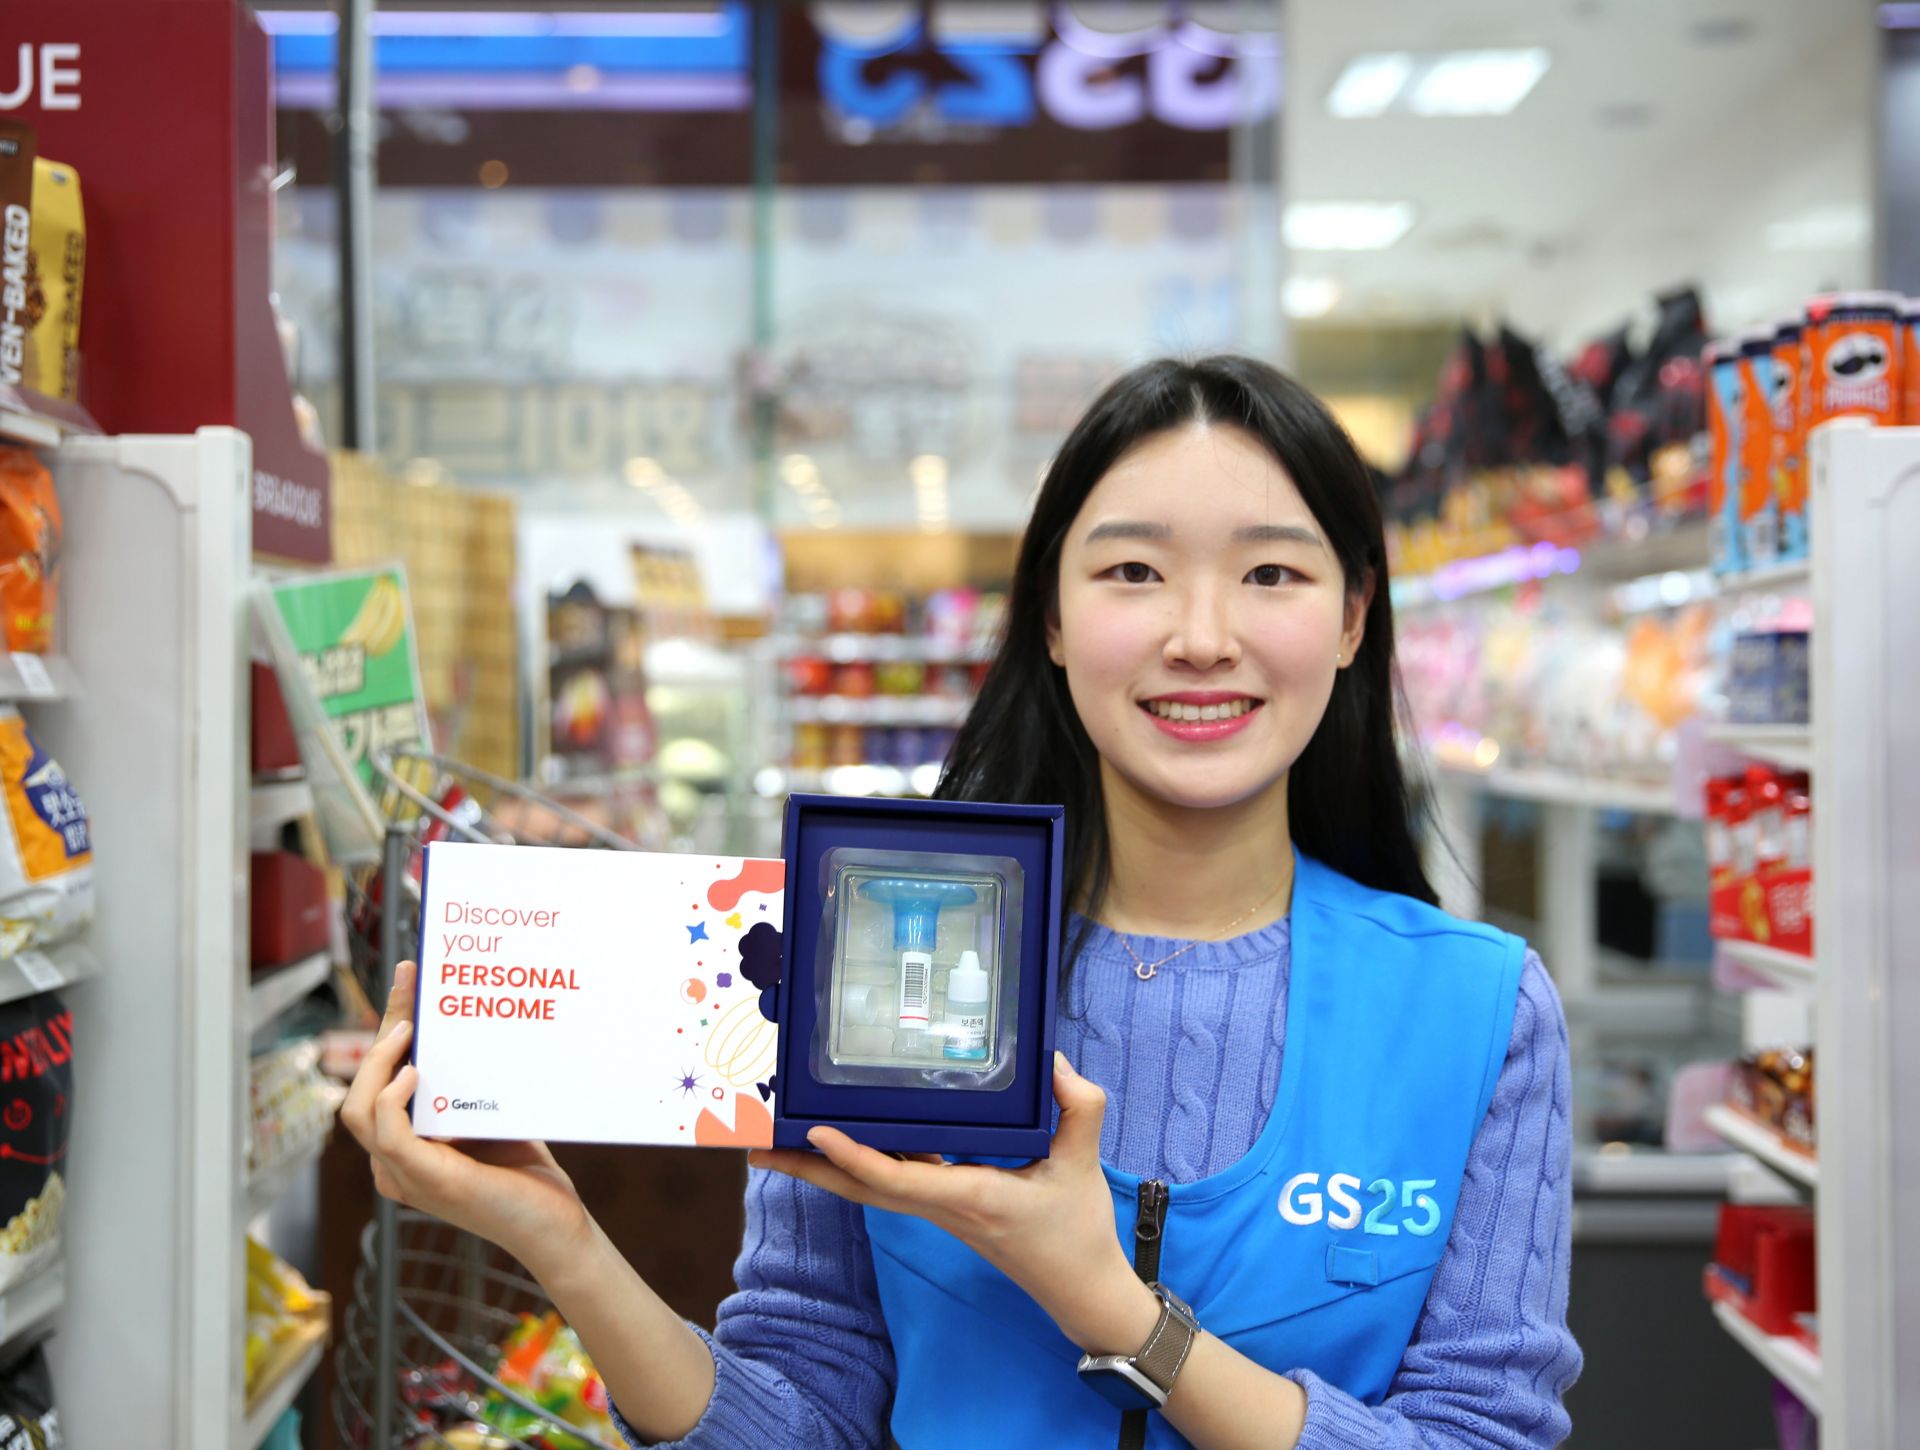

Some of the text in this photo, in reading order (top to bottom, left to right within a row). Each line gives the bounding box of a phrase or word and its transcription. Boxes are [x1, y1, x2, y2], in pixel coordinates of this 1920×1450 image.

[444, 901, 561, 928] Discover
[443, 933, 503, 959] your
[440, 963, 581, 990] PERSONAL
[438, 994, 556, 1021] GENOME
[961, 1017, 984, 1029] 보존액
[451, 1098, 500, 1111] GenTok
[1277, 1172, 1441, 1237] GS25
